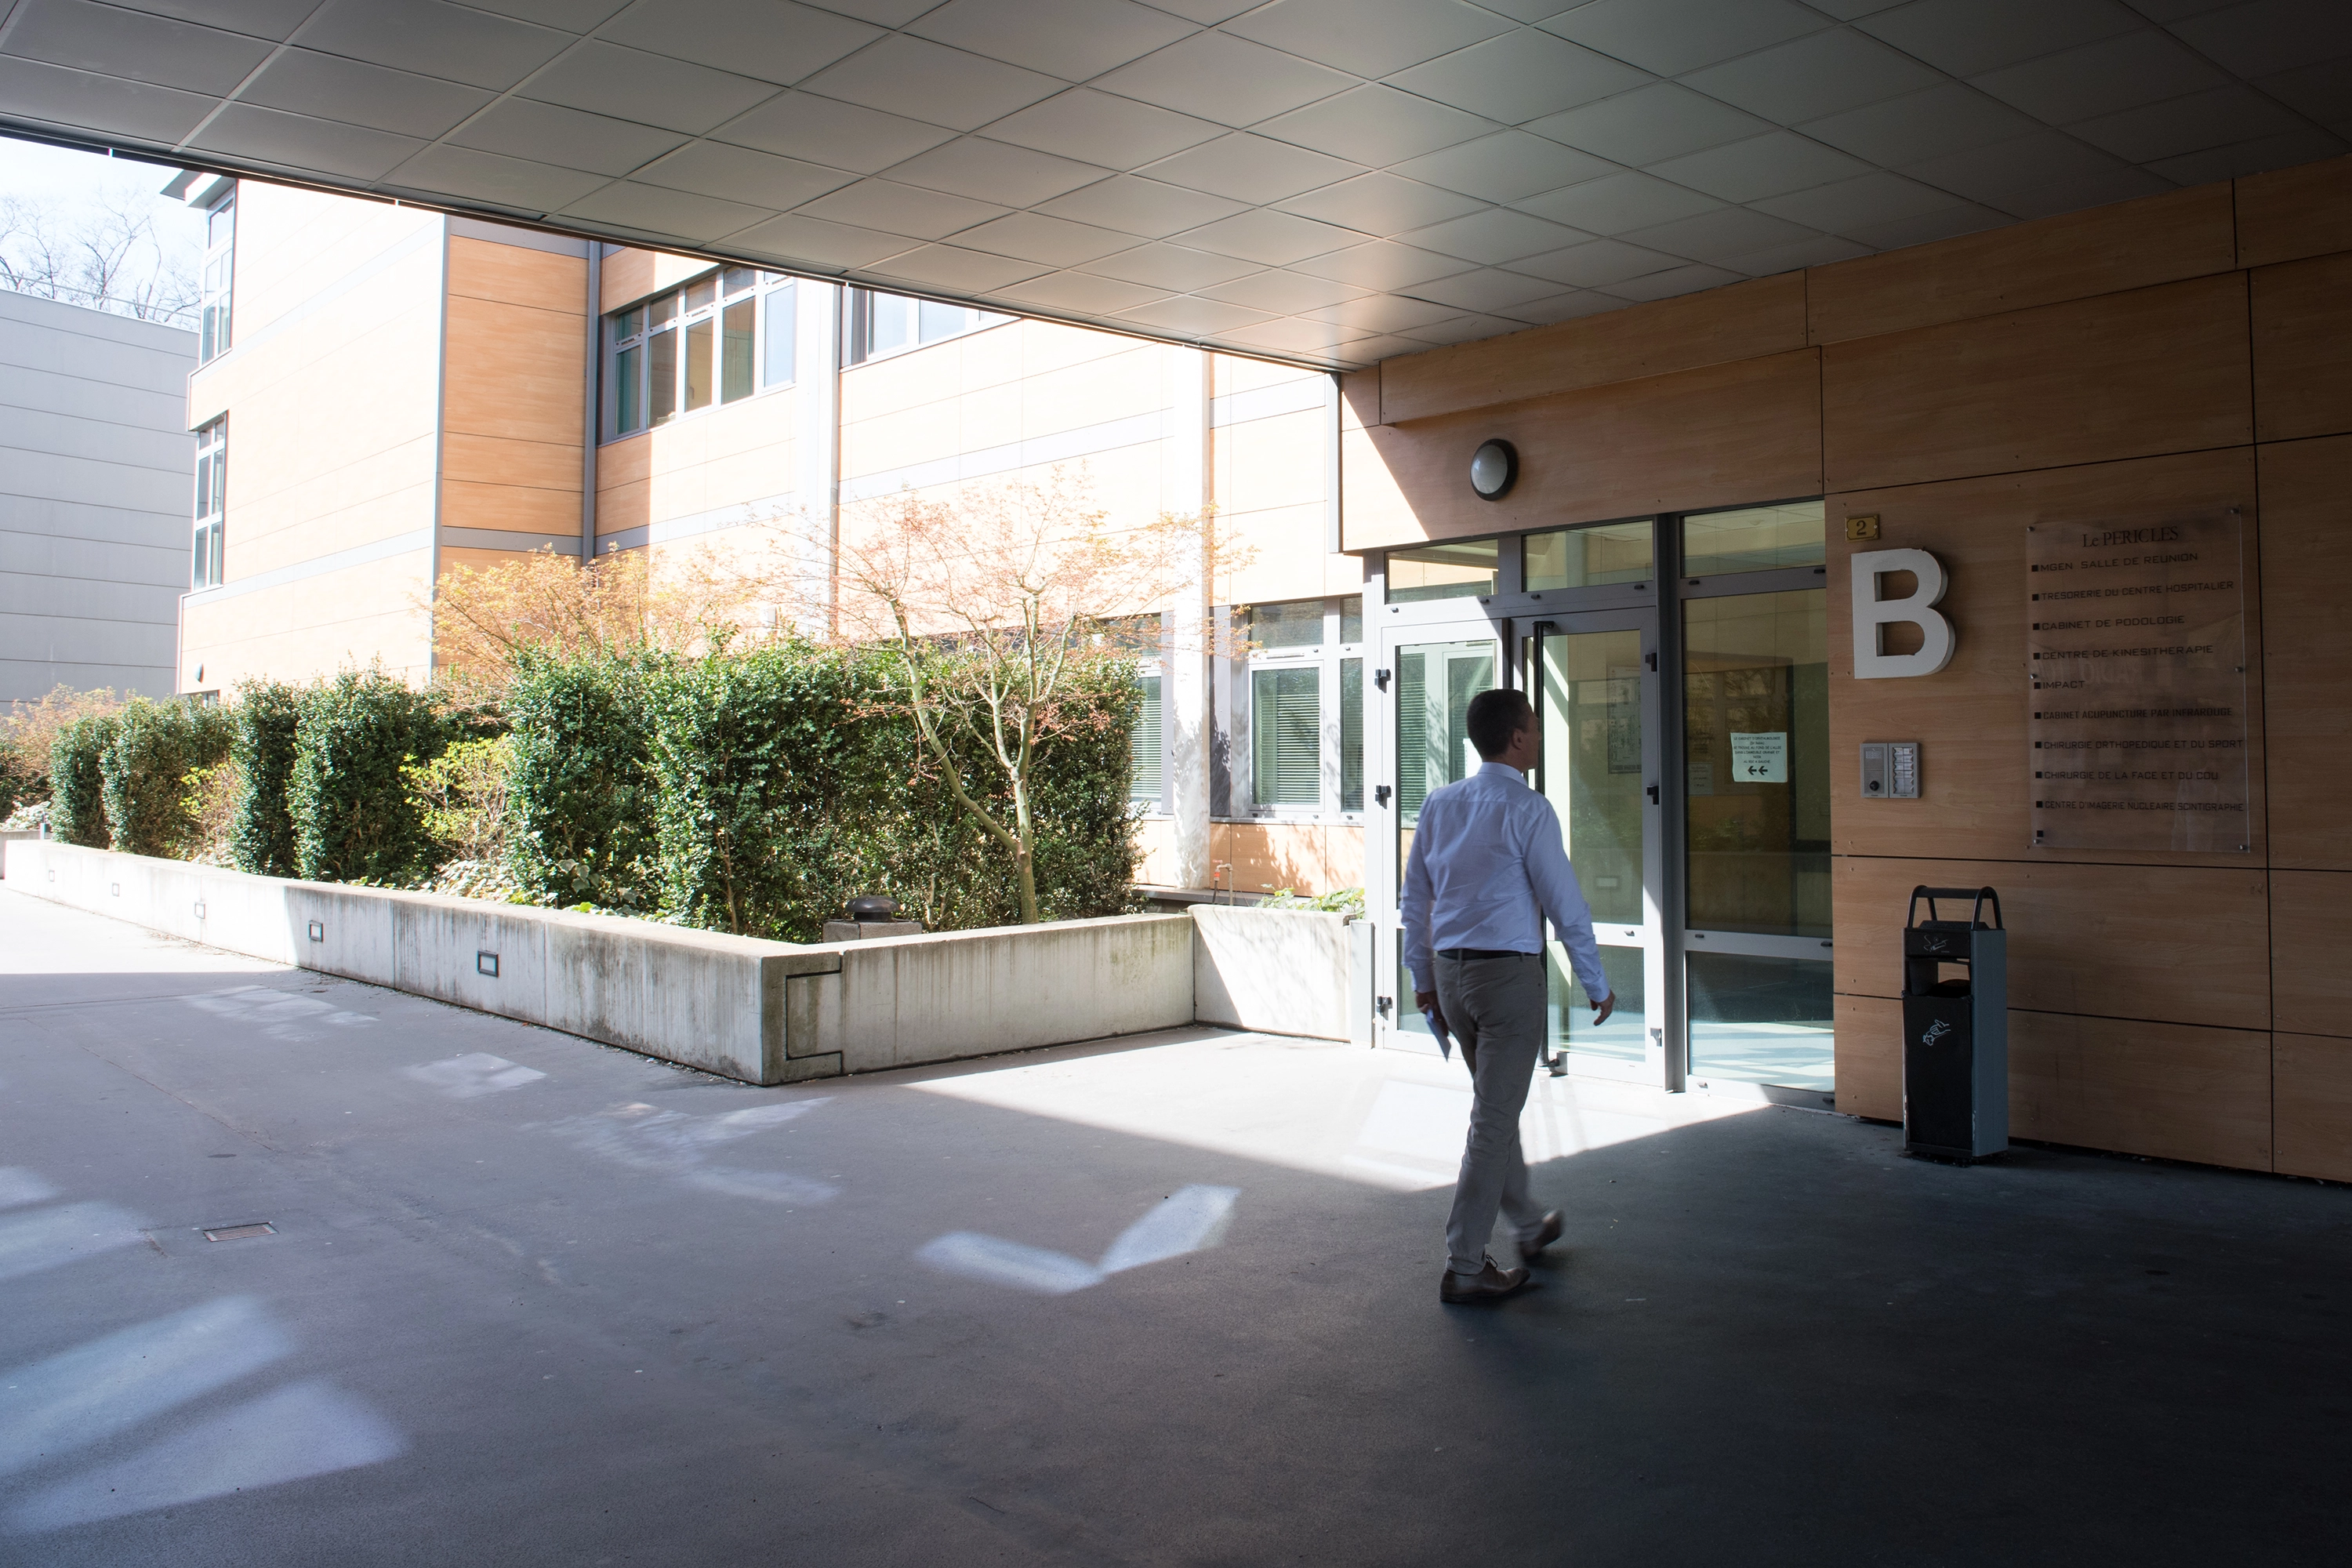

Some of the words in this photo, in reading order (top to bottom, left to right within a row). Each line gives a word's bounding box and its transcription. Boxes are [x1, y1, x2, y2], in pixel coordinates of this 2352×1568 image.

[1856, 520, 1867, 536] 2
[2082, 533, 2099, 548] Le
[2103, 525, 2180, 546] PERICLES
[2040, 563, 2073, 572] MGEN
[2081, 558, 2118, 569] SALLE
[2123, 557, 2140, 566] DE
[2143, 553, 2198, 564] REUNION
[2042, 589, 2102, 601] TRESORERIE
[2104, 589, 2118, 597] DU
[2122, 585, 2162, 597] CENTRE
[2165, 581, 2234, 593] HOSPITALIER
[1851, 548, 1955, 679] B
[2042, 620, 2091, 631] CABINET
[2096, 619, 2111, 628] DE
[2115, 615, 2185, 627] PODOLOGIE
[2042, 650, 2089, 660] CENTRE
[2092, 649, 2108, 658] DE
[2113, 645, 2213, 657] KINESITHERAPIE
[2042, 681, 2085, 689] IMPACT
[2043, 710, 2079, 720] CABINET
[2082, 709, 2148, 719] ACUPUNCTURE
[2151, 709, 2169, 717] PAR
[2172, 707, 2233, 717] INFRAROUGE
[2043, 741, 2092, 750] CHIRURGIE
[2095, 740, 2171, 749] ORTHOPEDIQUE
[2208, 739, 2243, 748] SPORT
[2044, 771, 2095, 779] CHIRURGIE
[2098, 771, 2111, 779] DE
[2132, 771, 2157, 780] FACE
[2161, 771, 2174, 780] ET
[2177, 771, 2193, 780] DU
[2196, 771, 2219, 780] COU
[2045, 800, 2077, 809] CENTRE
[2078, 801, 2125, 810] D'IMAGERIE
[2128, 801, 2175, 811] NUCLEAIRE
[2177, 802, 2244, 811] SCINTIGRAPHIE
